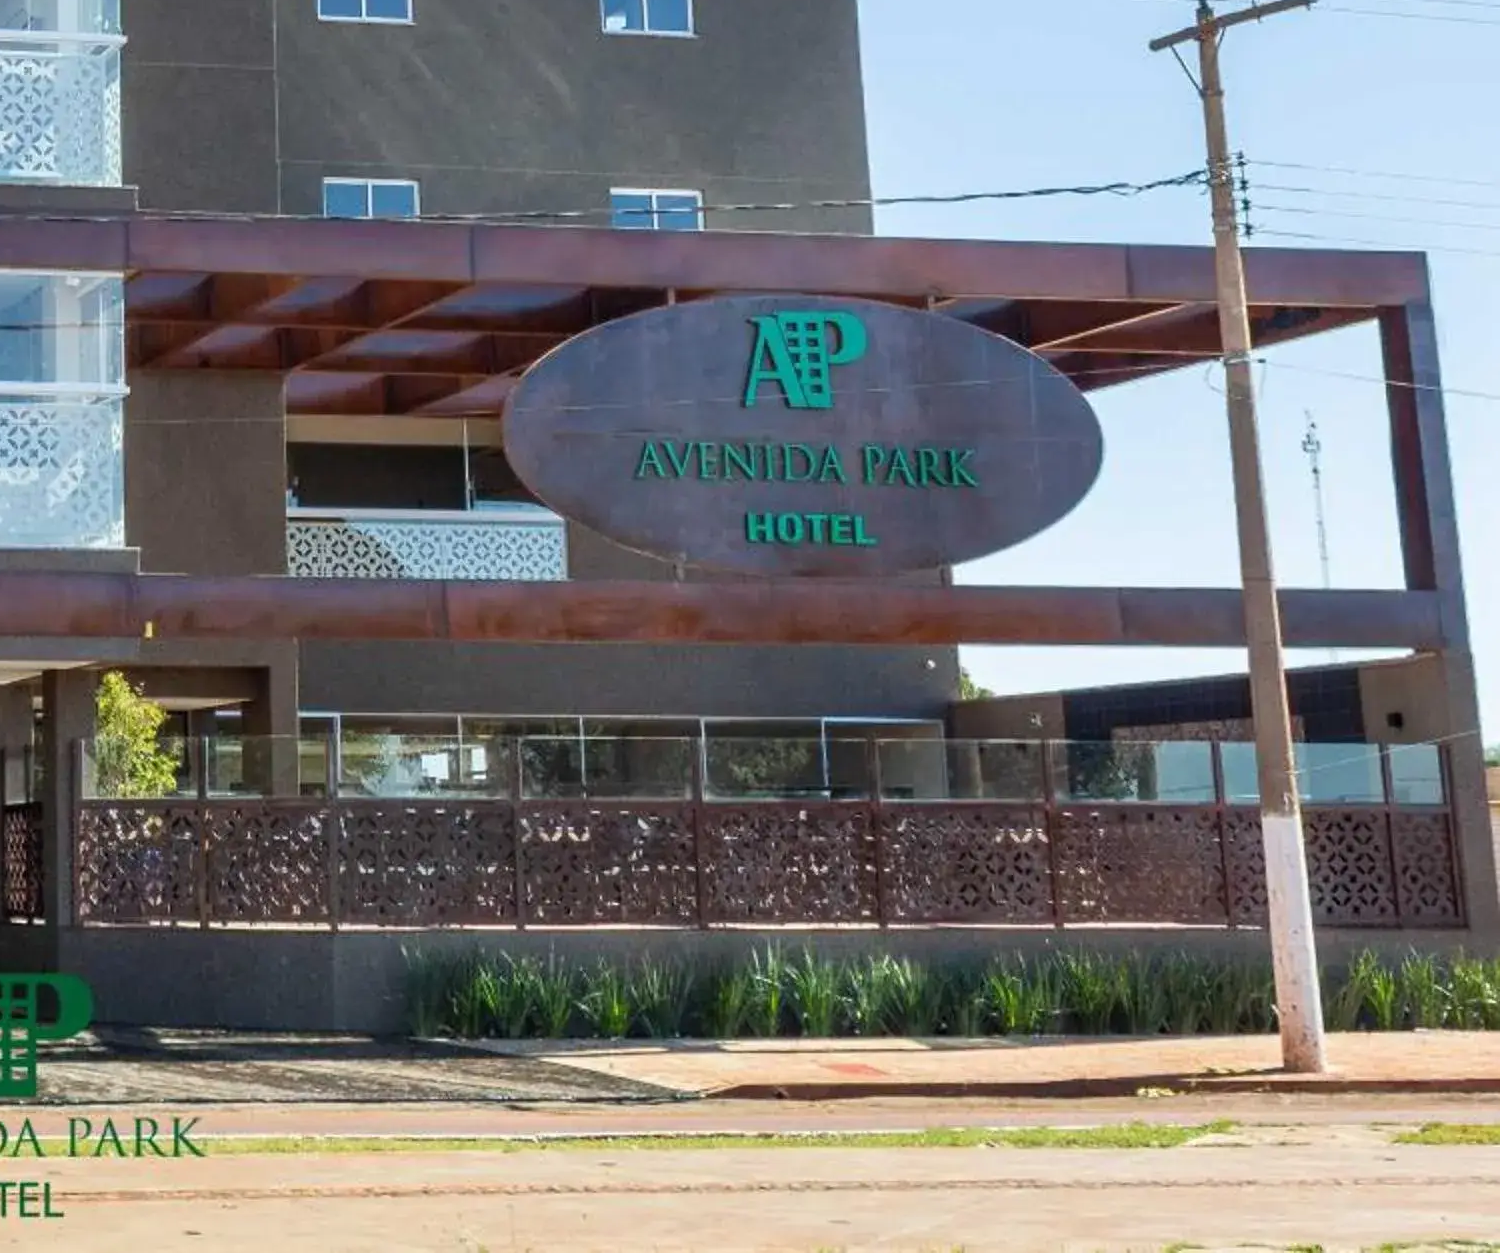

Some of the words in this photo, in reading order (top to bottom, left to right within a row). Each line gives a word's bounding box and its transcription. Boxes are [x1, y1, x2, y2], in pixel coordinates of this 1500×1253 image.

[636, 441, 846, 485] AVENIDA
[864, 445, 979, 488] PARK
[746, 513, 876, 546] HOTEL
